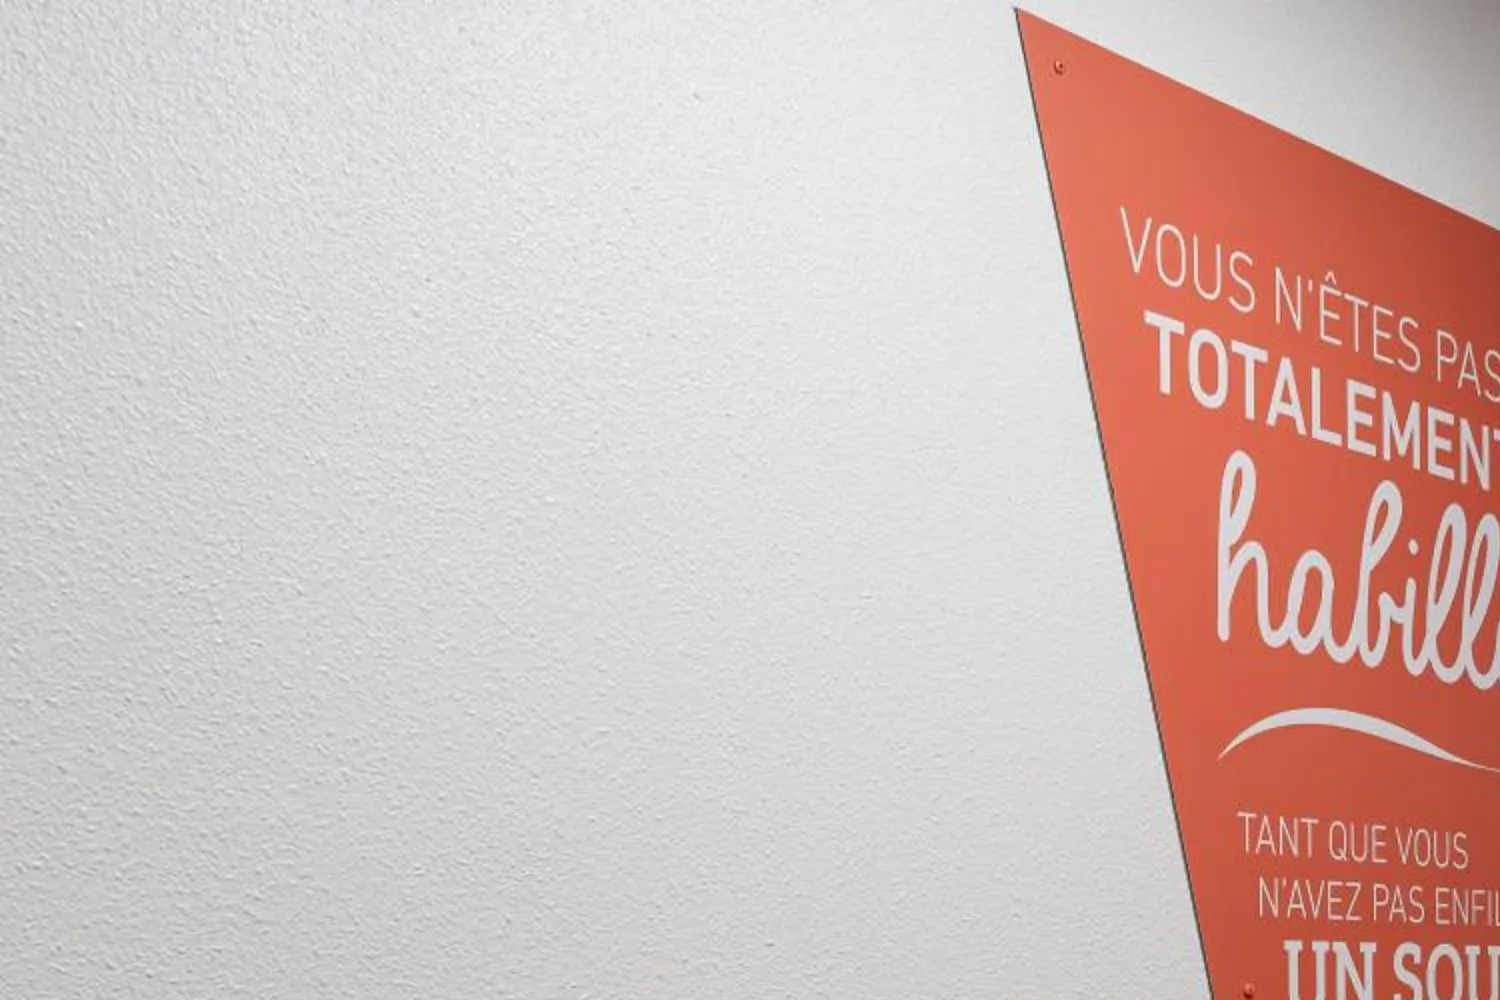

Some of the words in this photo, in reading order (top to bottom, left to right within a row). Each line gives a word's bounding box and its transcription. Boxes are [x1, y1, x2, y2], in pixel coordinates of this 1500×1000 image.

[1120, 206, 1256, 313] VOUS
[1274, 266, 1422, 372] N'ÊTES
[1237, 811, 1318, 858] TANT
[1328, 820, 1388, 864] QUE
[1395, 827, 1470, 870] VOUS
[1258, 876, 1362, 922] N'AVEZ
[1372, 883, 1426, 925] PAS
